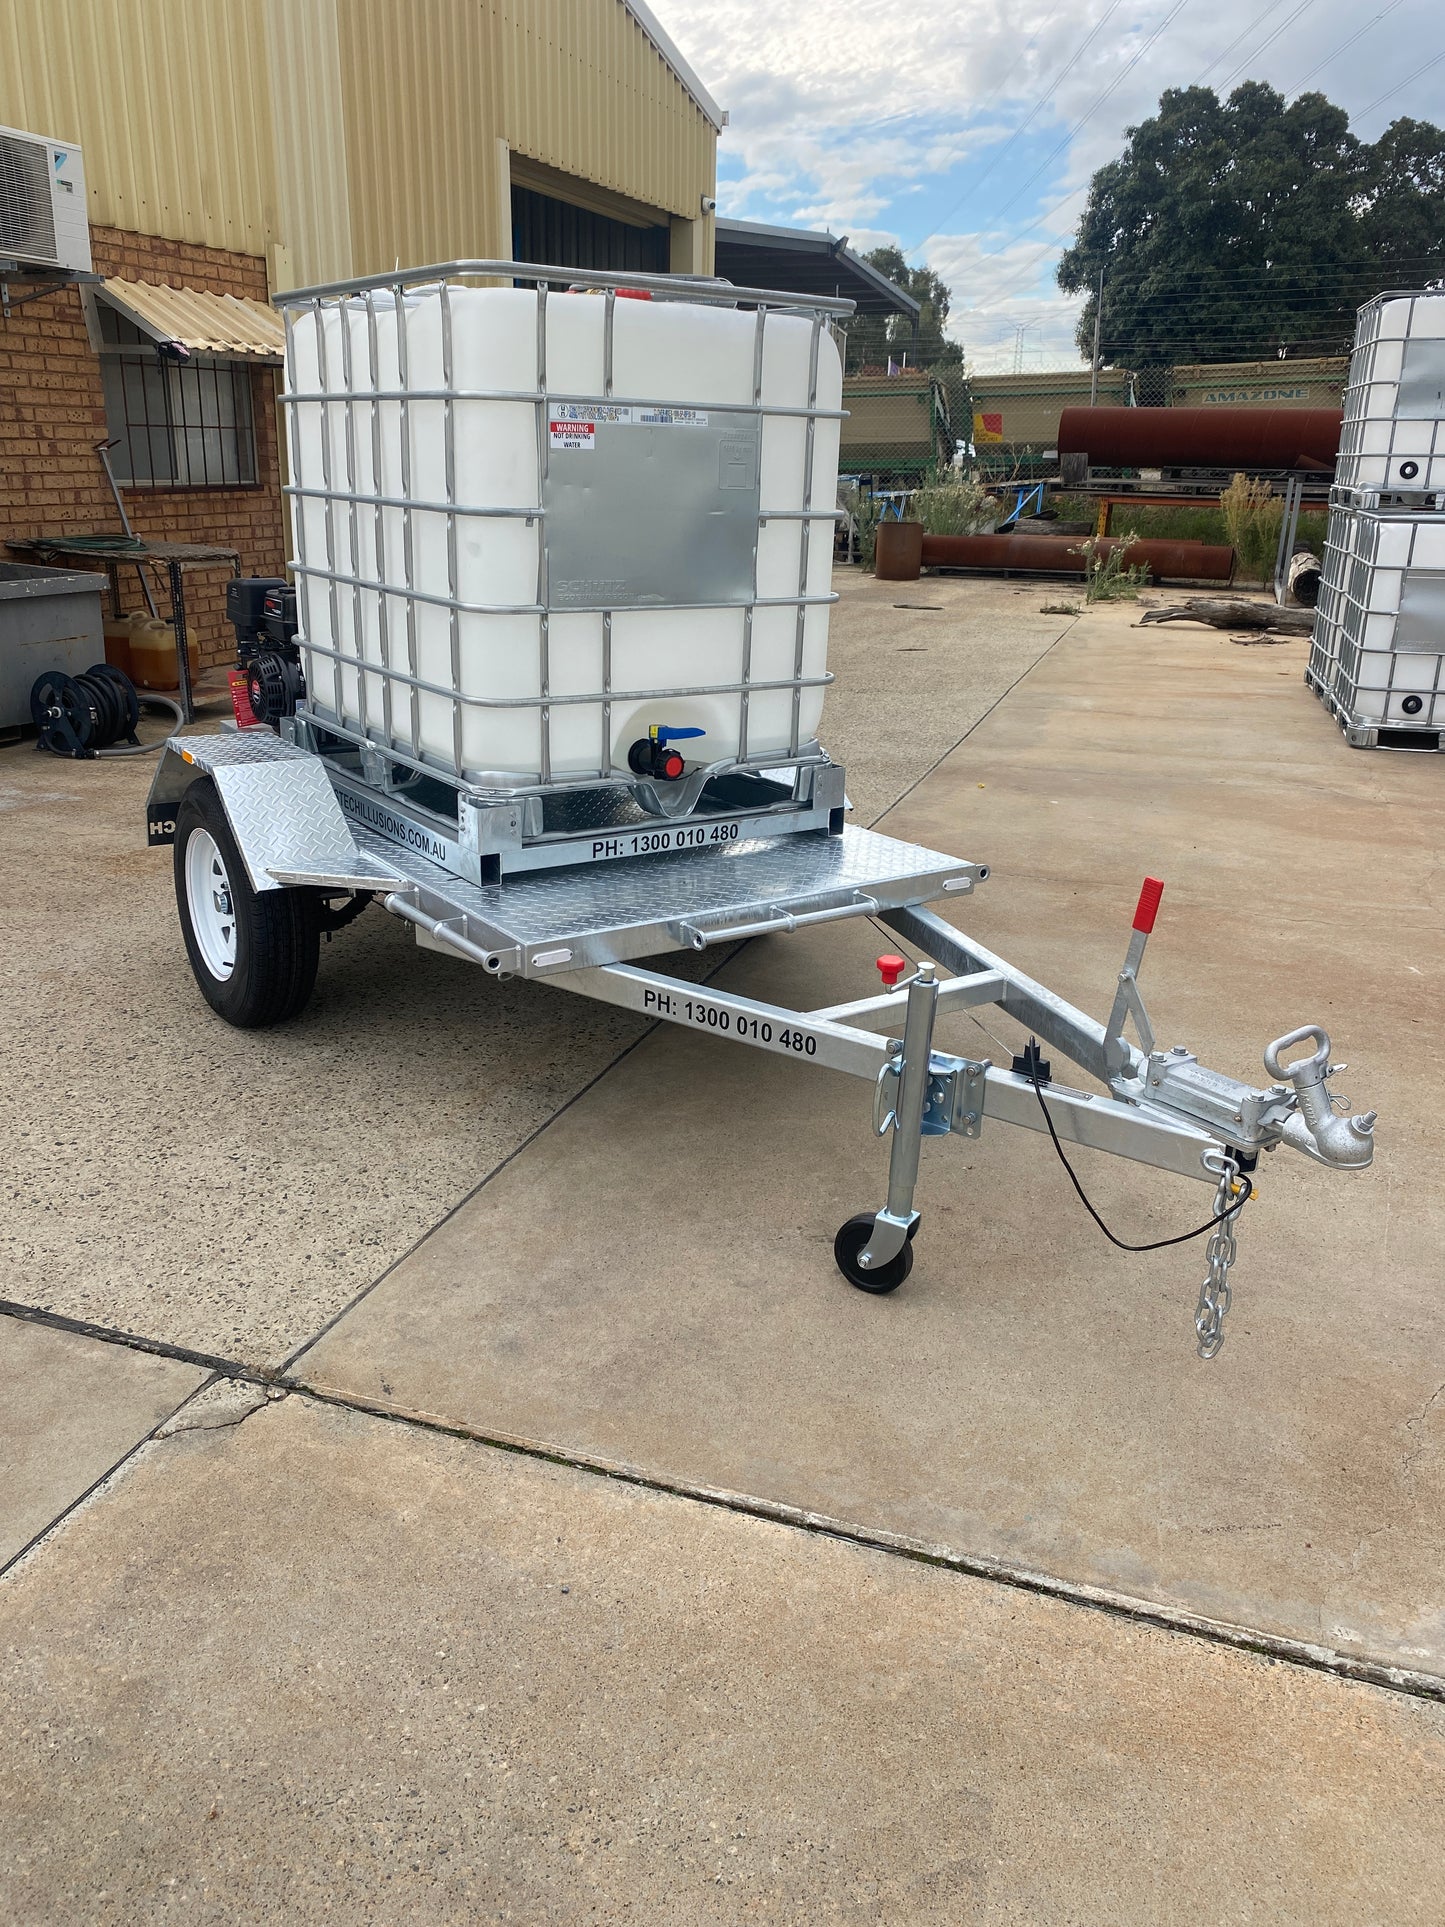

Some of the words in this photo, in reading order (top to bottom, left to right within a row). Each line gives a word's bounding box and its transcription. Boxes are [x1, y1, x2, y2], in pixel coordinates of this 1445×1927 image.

[1204, 388, 1309, 402] AMAZONE
[556, 423, 589, 433] WARNING
[592, 840, 624, 859] PH:
[630, 832, 671, 853] 1300
[676, 827, 705, 847] 010
[710, 823, 739, 842] 480
[643, 989, 677, 1015] PH:
[684, 1001, 730, 1030] 1300
[736, 1016, 773, 1043] 010
[778, 1030, 817, 1056] 480
